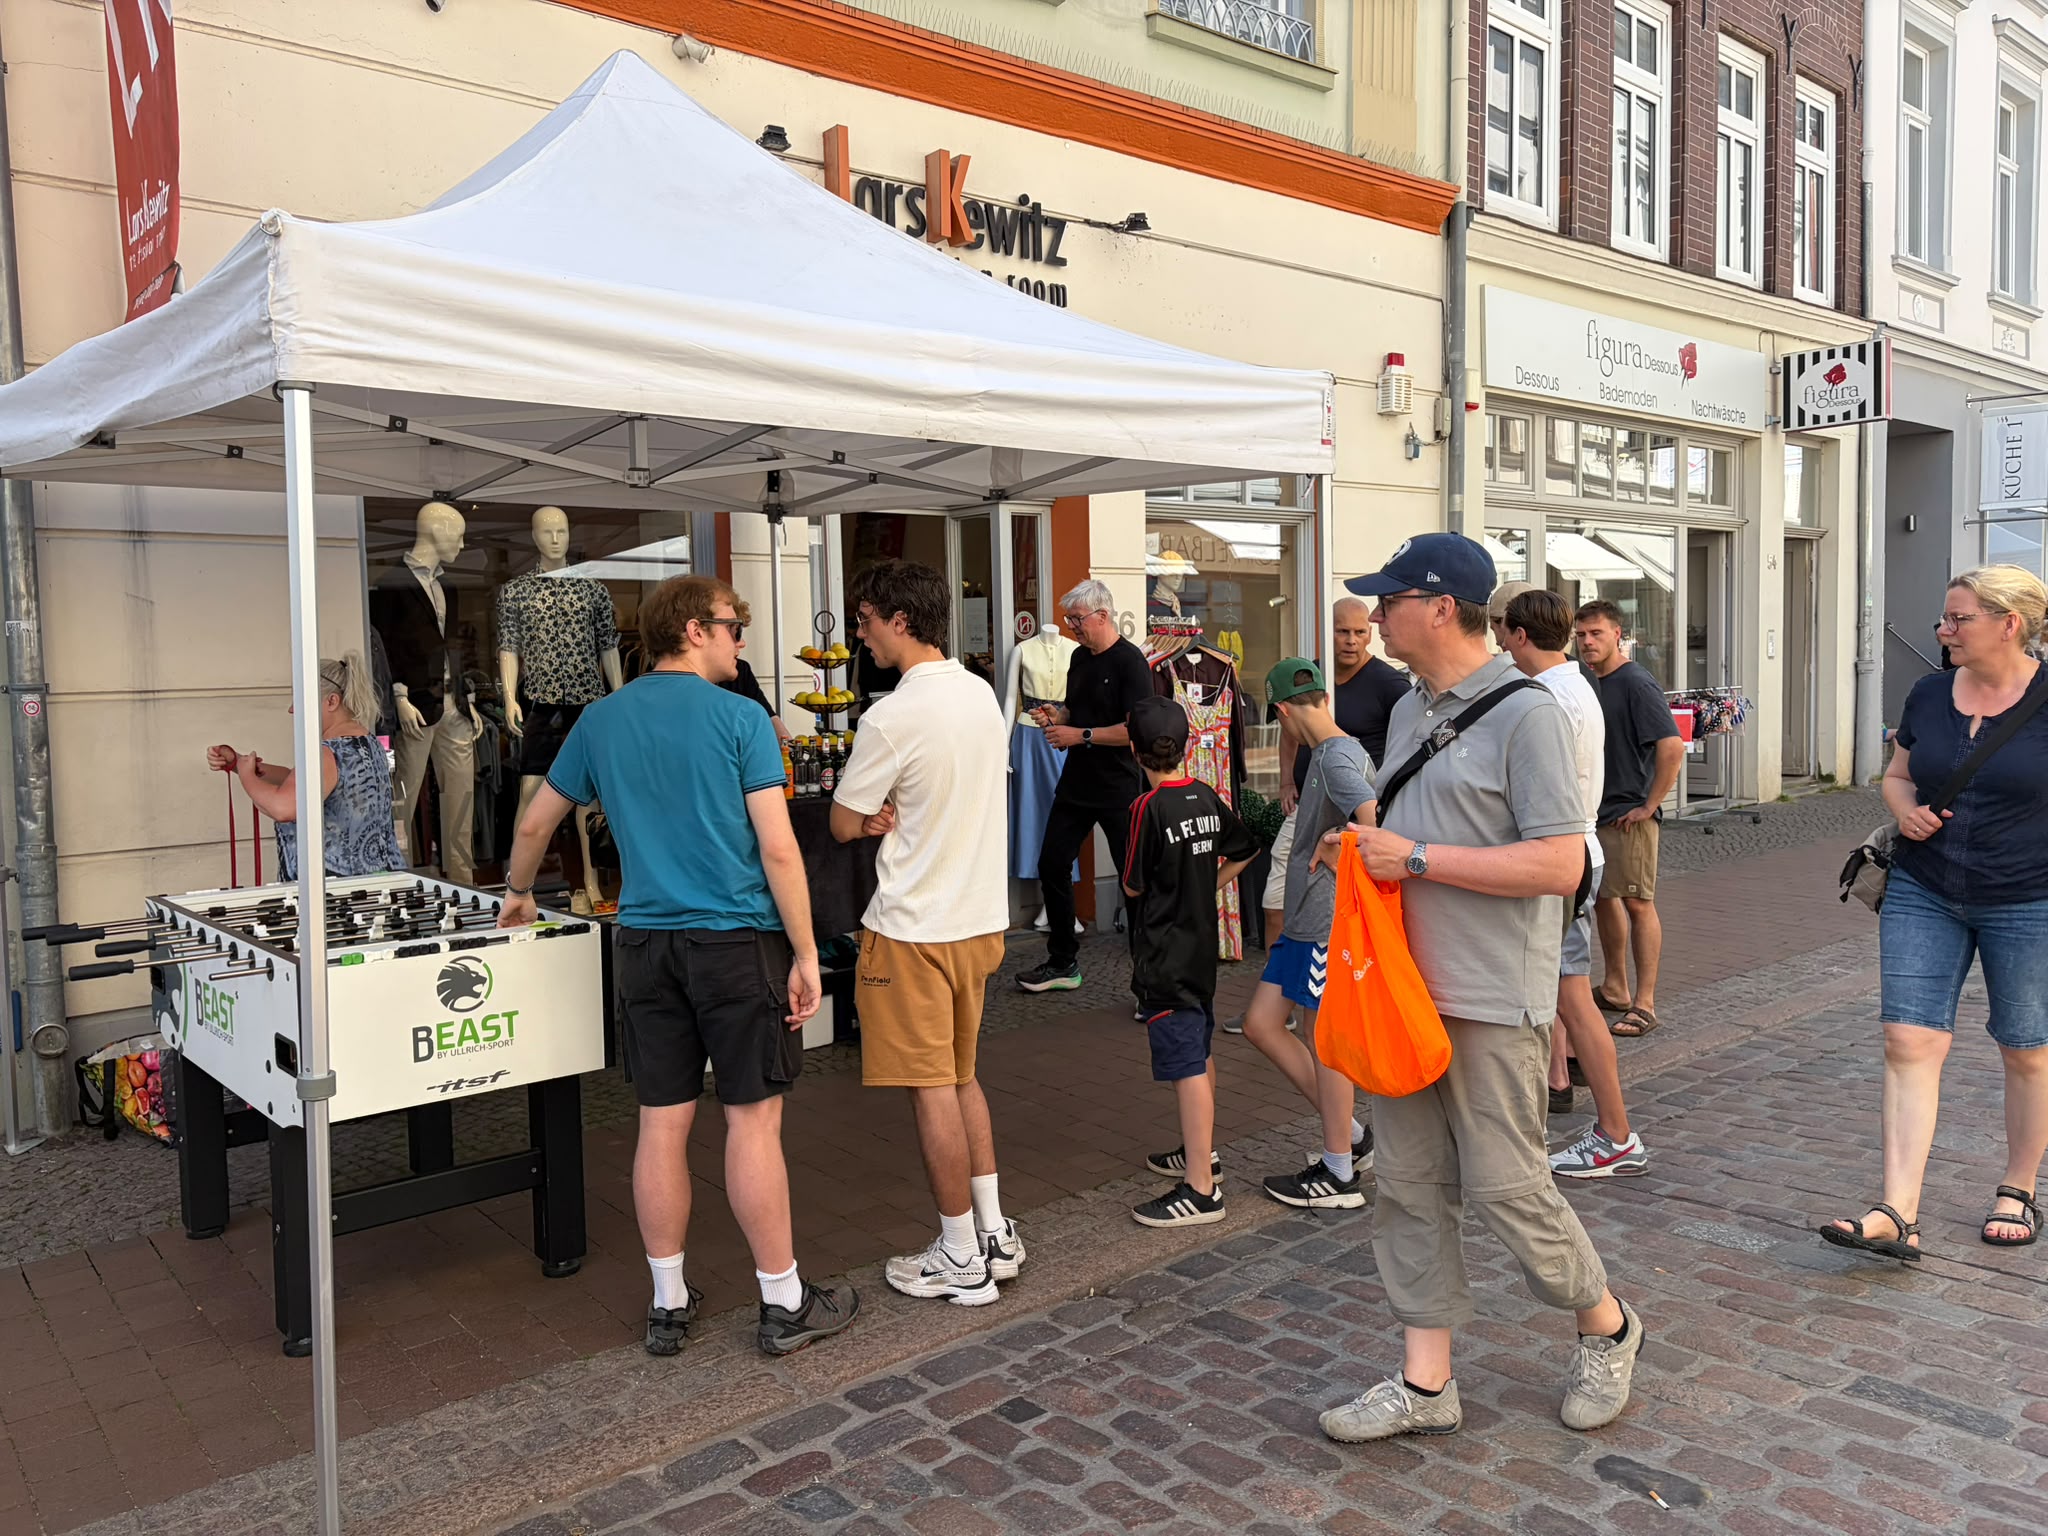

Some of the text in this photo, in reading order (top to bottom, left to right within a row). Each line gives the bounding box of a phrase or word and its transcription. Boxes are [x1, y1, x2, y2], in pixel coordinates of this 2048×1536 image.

[125, 197, 145, 246] Lars
[925, 149, 1068, 267] Kewitz
[1586, 319, 1679, 378] figura Dessous
[1515, 365, 1560, 392] Dessous
[1599, 382, 1658, 409] Bademoden
[1804, 385, 1859, 409] figura
[1828, 398, 1862, 408] Dessous
[1691, 399, 1746, 424] Nachtwäsche
[2002, 434, 2023, 500] KÜCHE
[1766, 553, 1777, 570] 54
[1165, 826, 1181, 845] 1.
[1179, 818, 1196, 839] FC
[194, 978, 235, 1036] BEAST
[412, 1010, 520, 1063] BEAST
[437, 1038, 515, 1060] BY ULLRICH-SPORT
